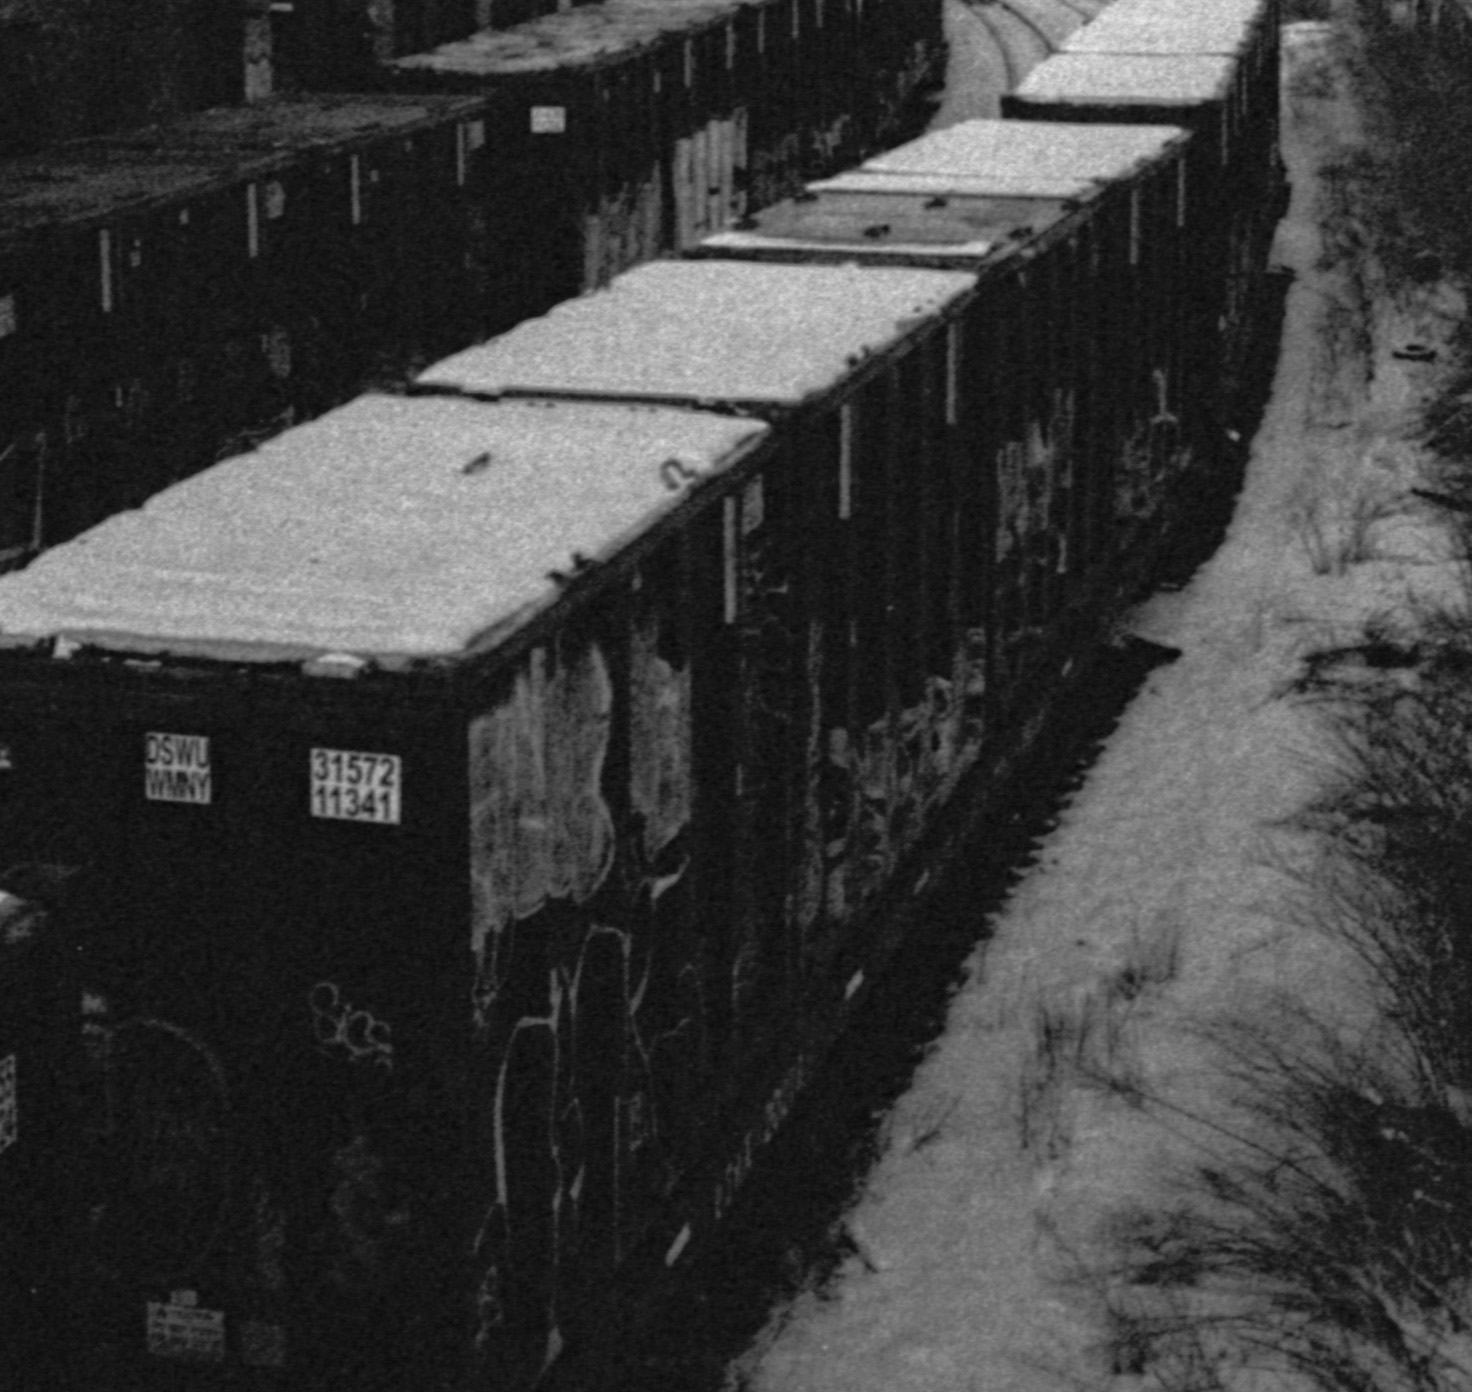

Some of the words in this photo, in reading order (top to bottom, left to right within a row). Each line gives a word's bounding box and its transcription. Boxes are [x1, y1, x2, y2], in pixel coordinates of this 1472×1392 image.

[146, 734, 210, 768] DSWU
[313, 751, 396, 789] 31572
[314, 784, 394, 821] 11341
